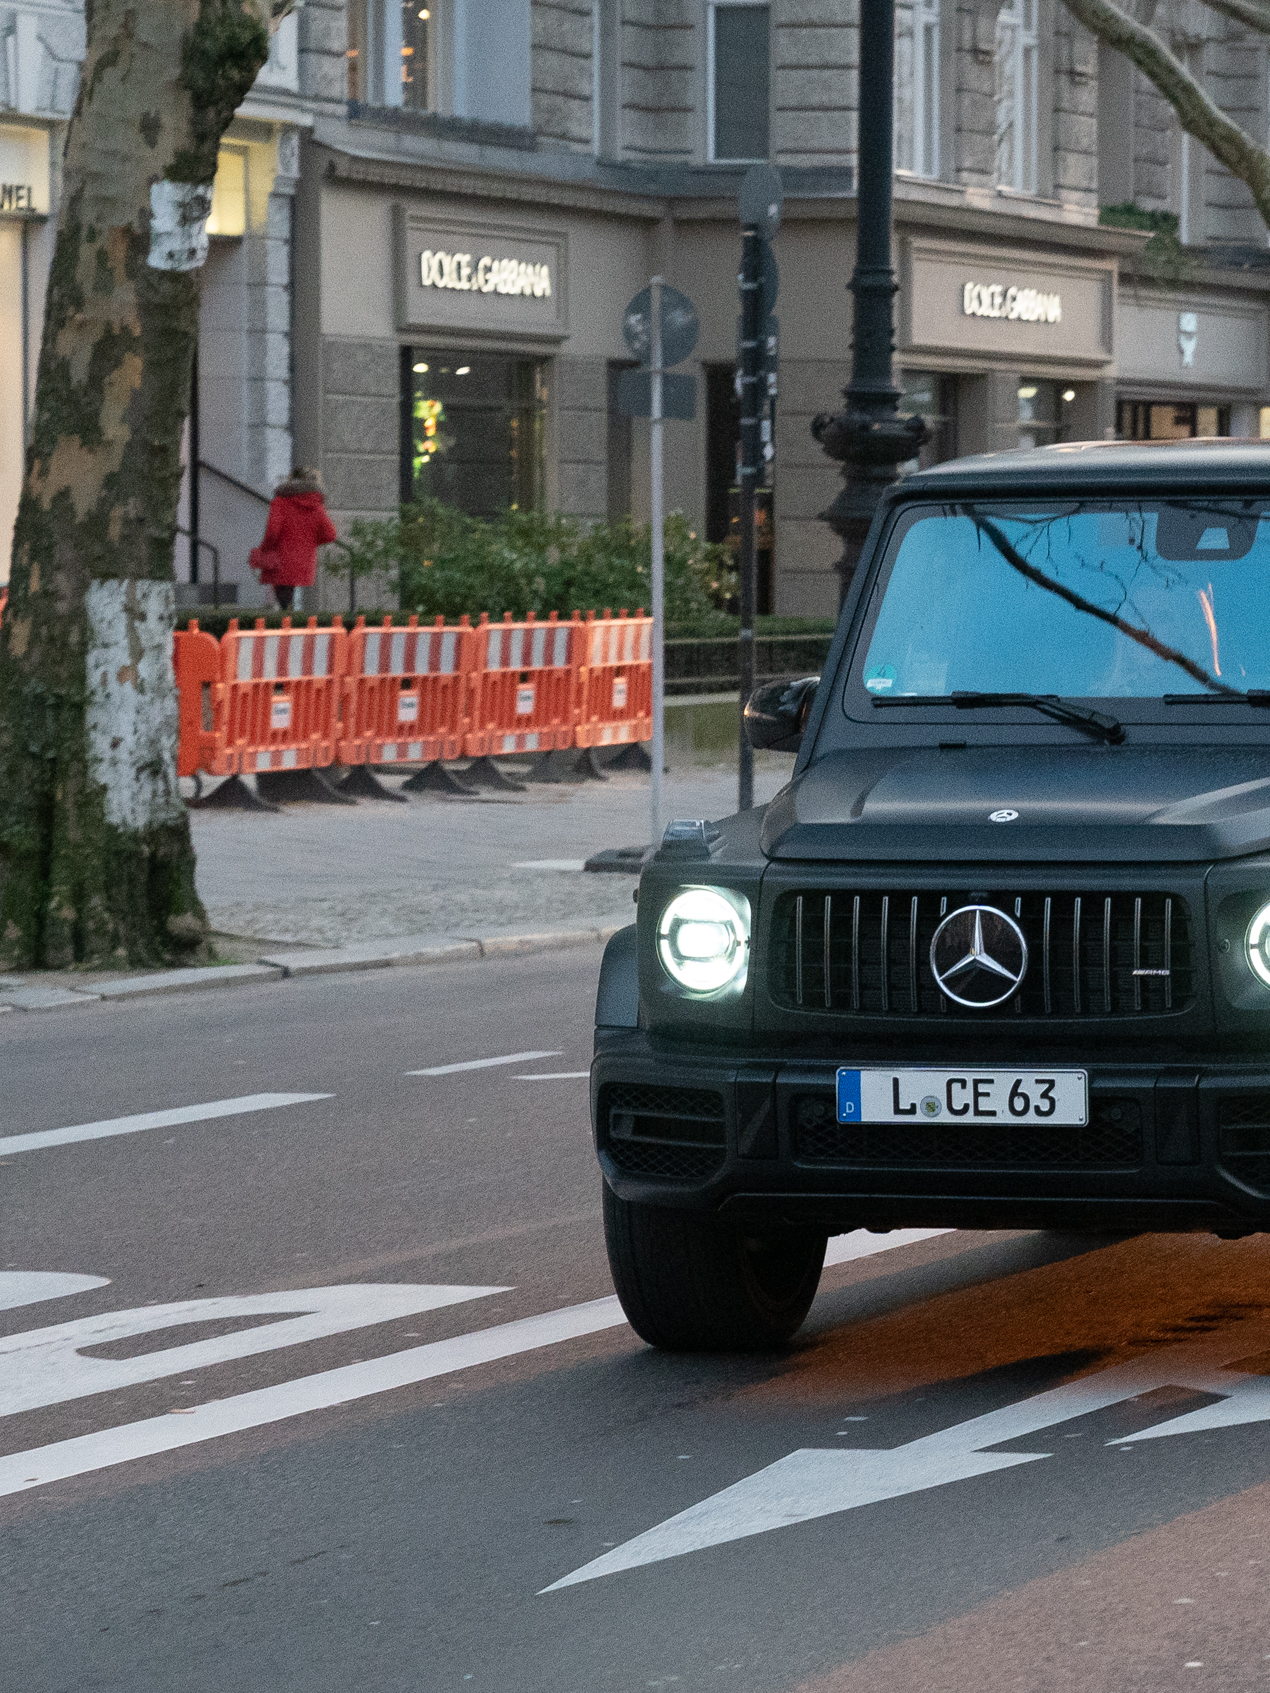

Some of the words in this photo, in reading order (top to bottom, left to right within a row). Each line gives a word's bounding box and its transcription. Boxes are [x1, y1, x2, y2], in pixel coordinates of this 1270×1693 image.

[845, 1102, 855, 1113] D
[892, 1077, 917, 1116] L
[946, 1078, 998, 1117] CE
[1008, 1078, 1057, 1117] 63
